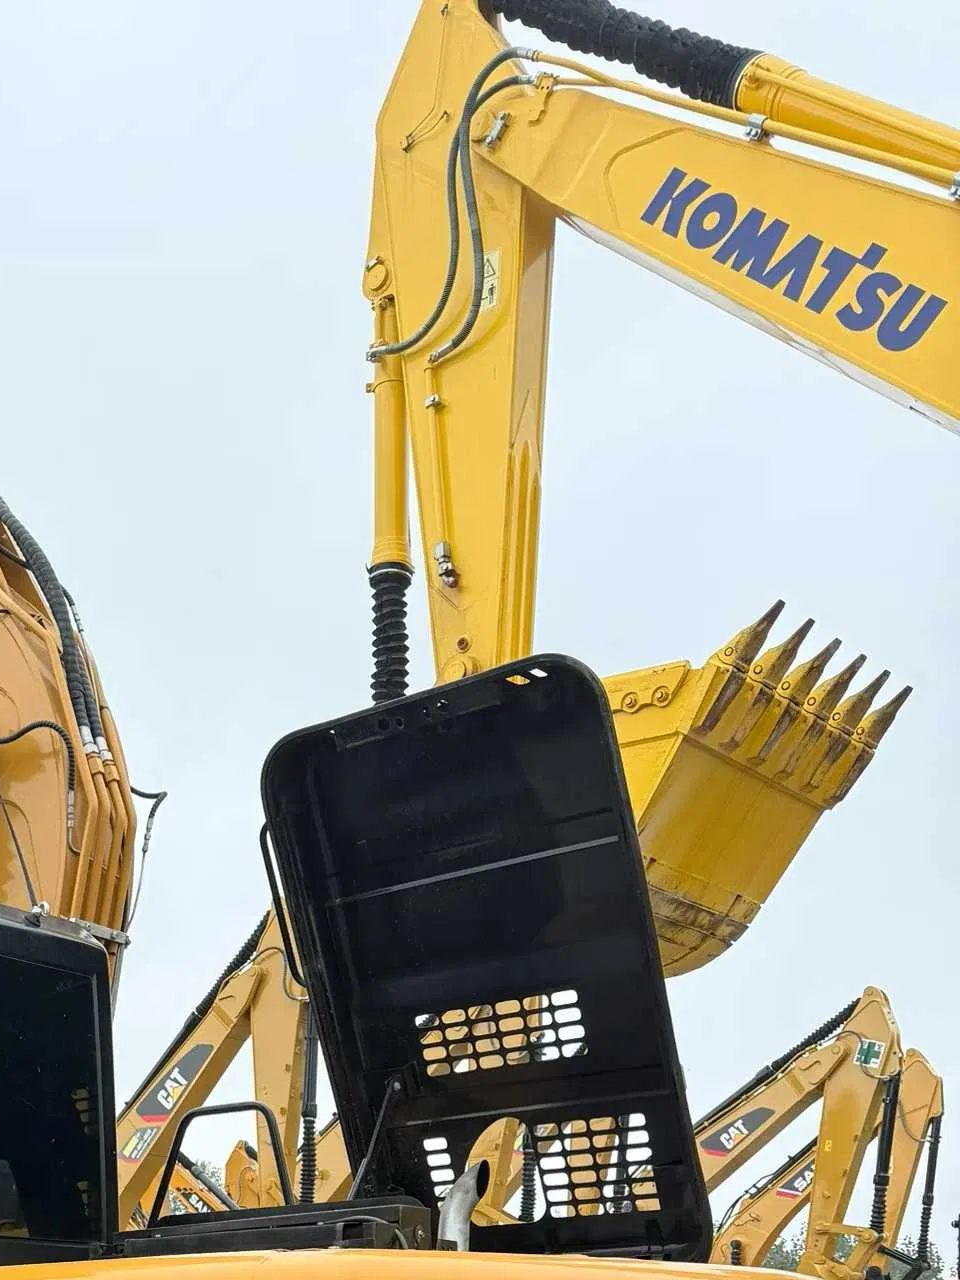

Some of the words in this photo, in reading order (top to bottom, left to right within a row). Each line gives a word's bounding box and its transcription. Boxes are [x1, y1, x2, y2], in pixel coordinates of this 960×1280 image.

[640, 166, 949, 352] KOMATSU
[157, 1066, 188, 1110] CAT
[720, 1119, 749, 1149] CAT
[793, 1166, 815, 1192] SA
